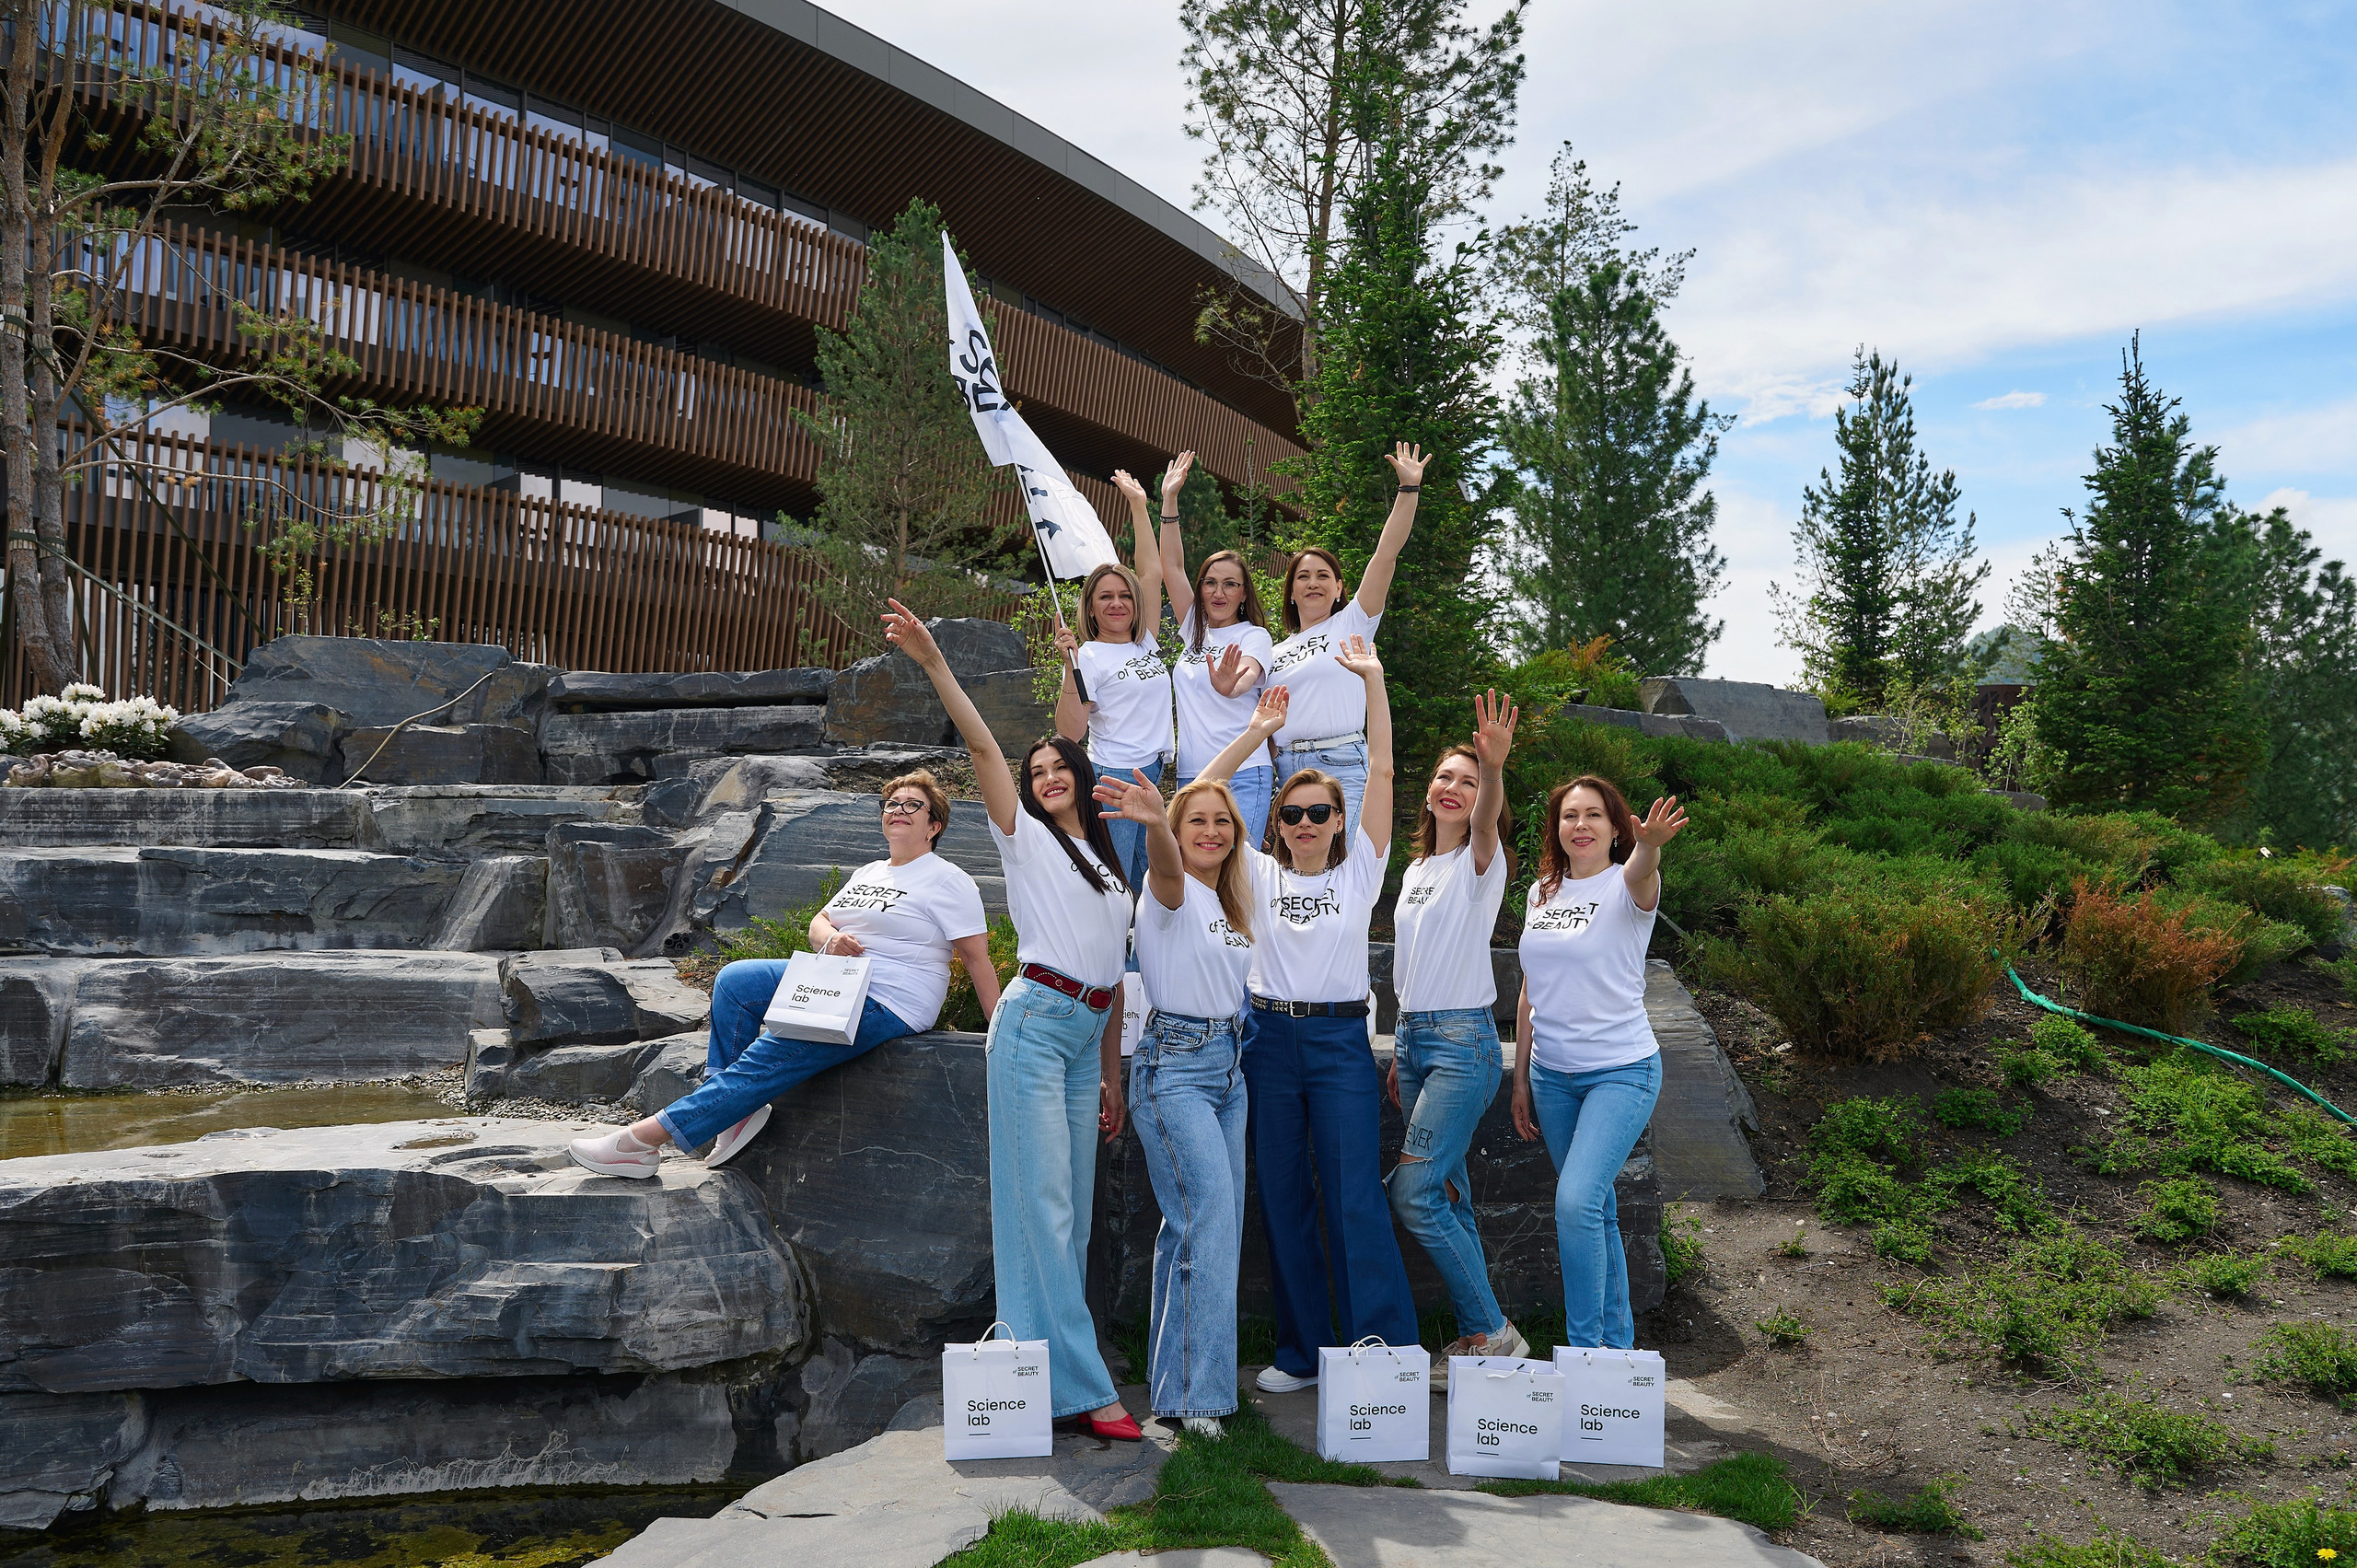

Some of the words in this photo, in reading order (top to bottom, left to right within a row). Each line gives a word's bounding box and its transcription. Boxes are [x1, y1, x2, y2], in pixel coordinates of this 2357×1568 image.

[1135, 666, 1167, 680] BEAU
[847, 884, 908, 900] SECRET
[1411, 887, 1434, 895] SECRE
[832, 897, 896, 912] BEAUTY
[795, 984, 841, 997] Science
[792, 993, 809, 1003] lab
[968, 1399, 1026, 1411] Science
[1350, 1403, 1406, 1416] Science
[1581, 1404, 1640, 1419] Science
[968, 1414, 990, 1426] lab
[1350, 1418, 1371, 1430] lab
[1477, 1418, 1538, 1434] Science
[1580, 1418, 1603, 1431] lab
[1477, 1433, 1500, 1446] lab
